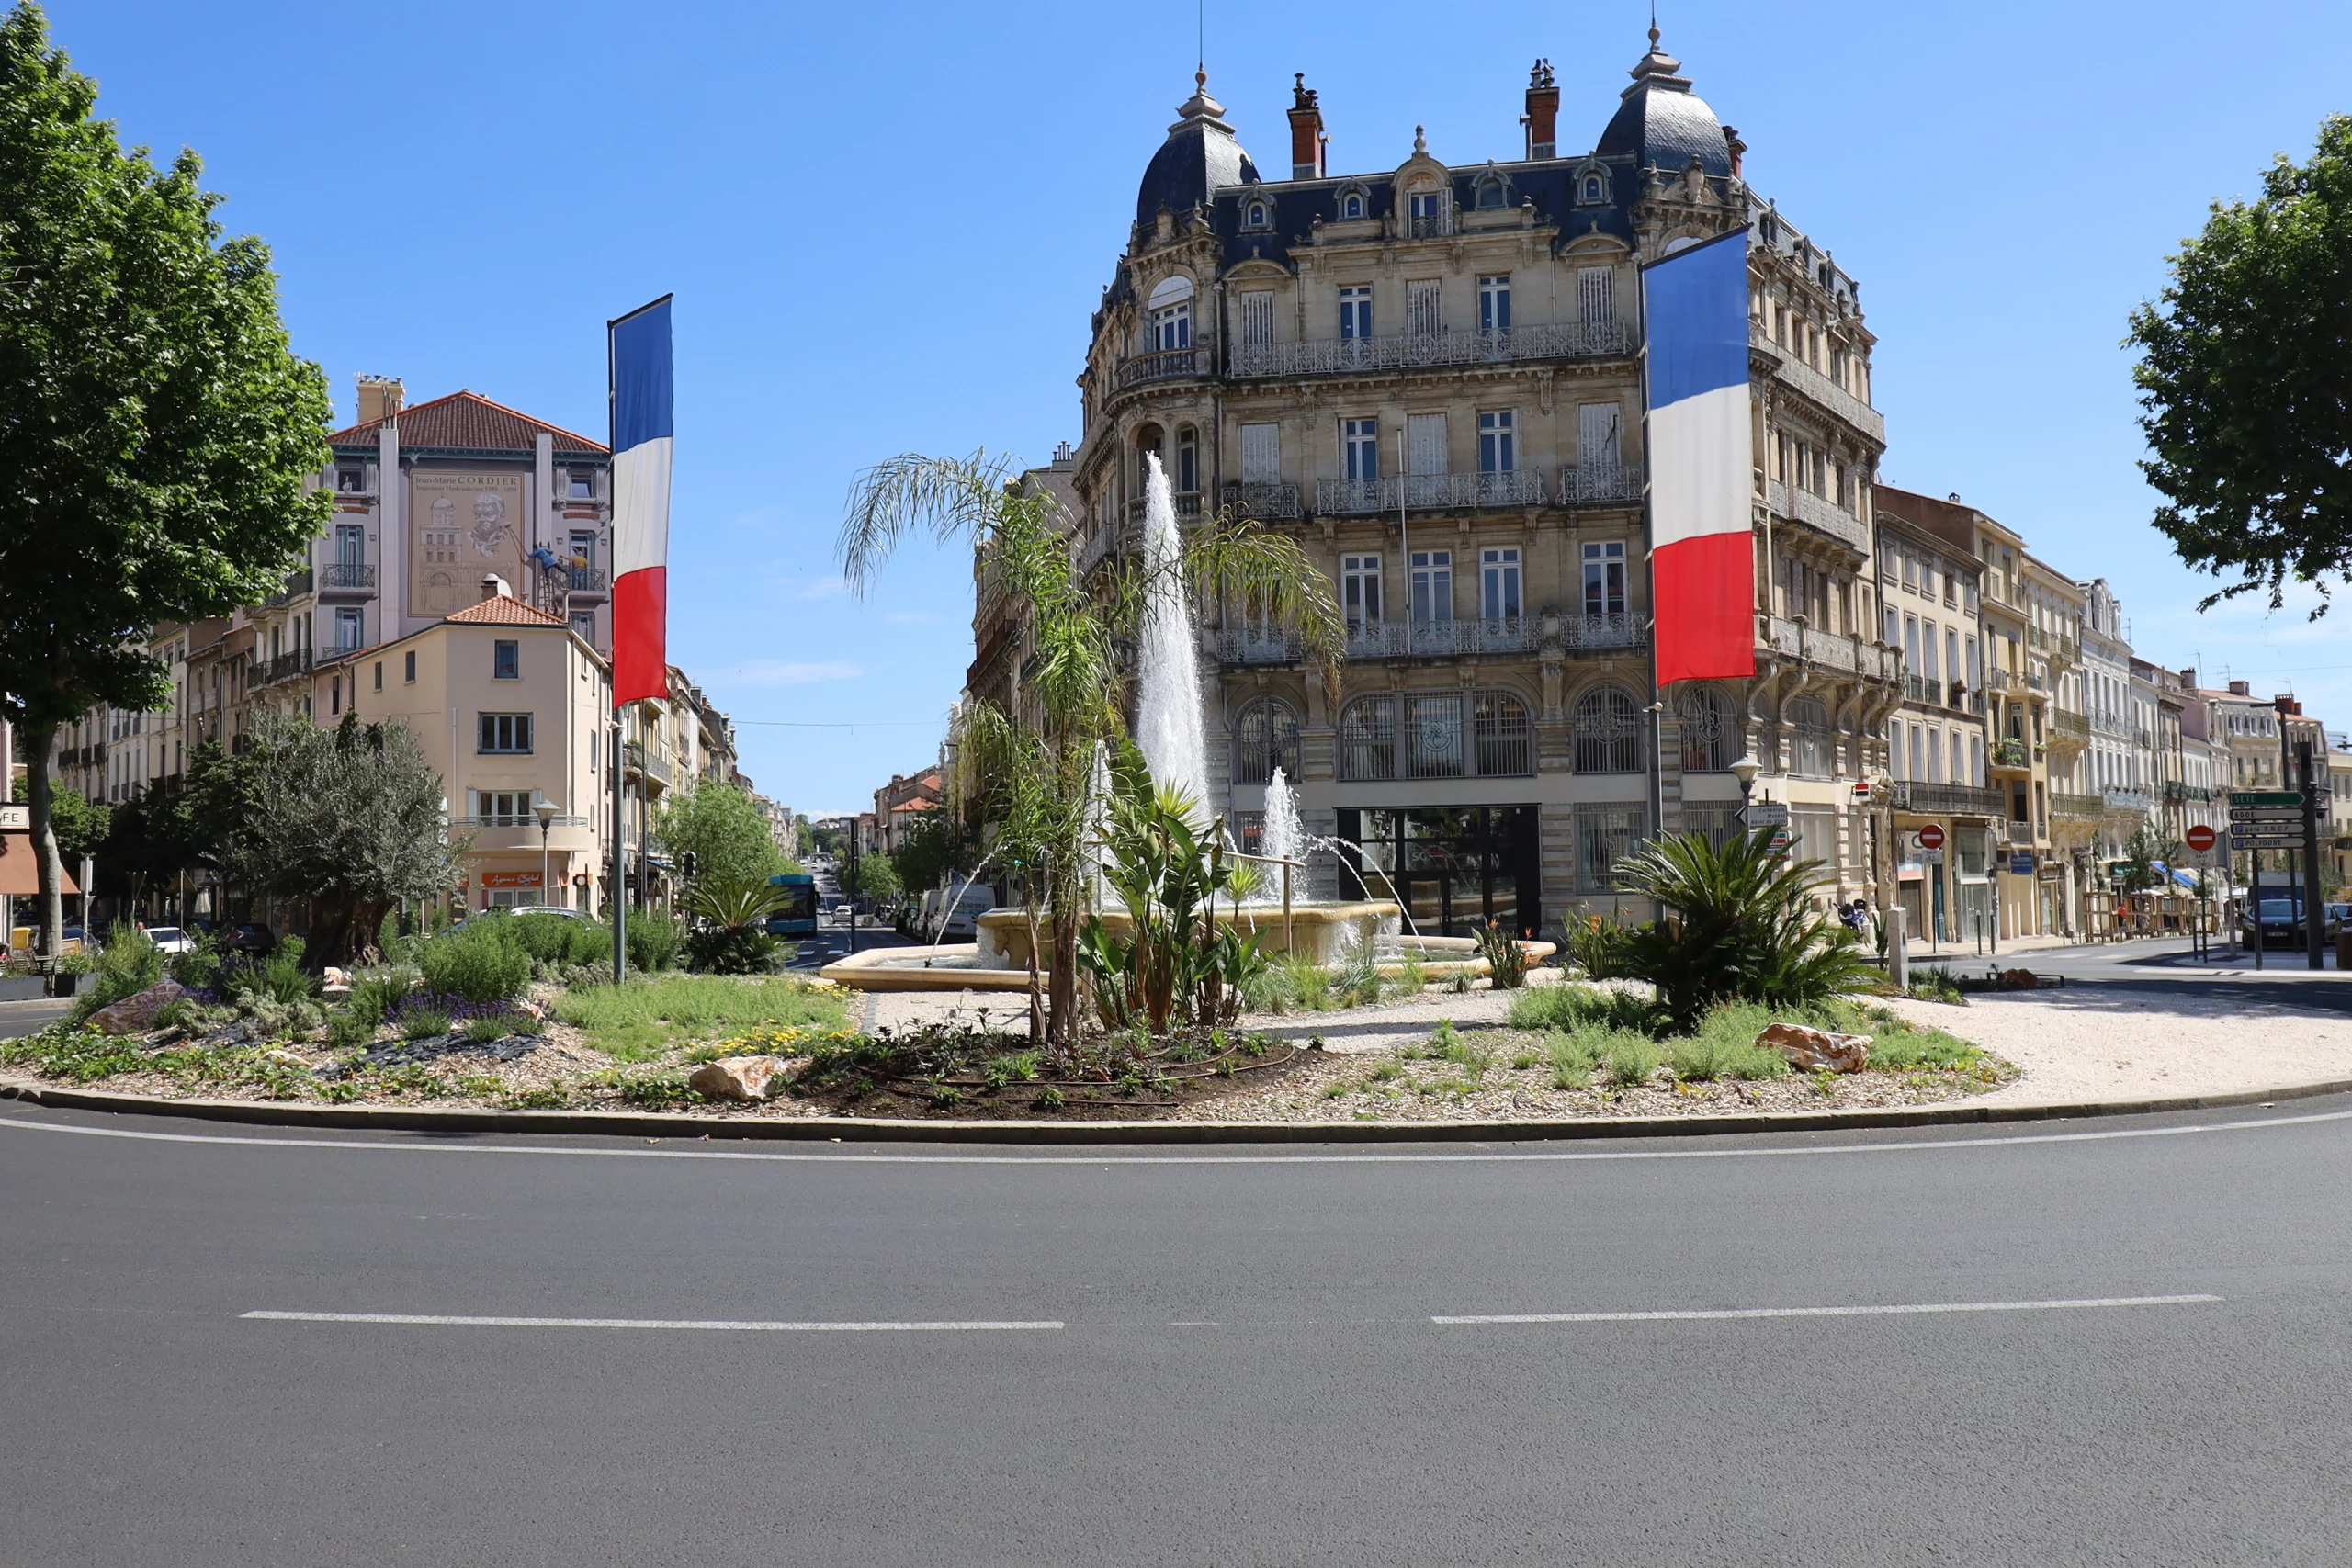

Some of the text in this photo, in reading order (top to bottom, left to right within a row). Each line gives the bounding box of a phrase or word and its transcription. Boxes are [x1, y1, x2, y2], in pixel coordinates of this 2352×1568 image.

[415, 476, 517, 485] Jean-Marie CORDIER
[0, 812, 19, 823] FE
